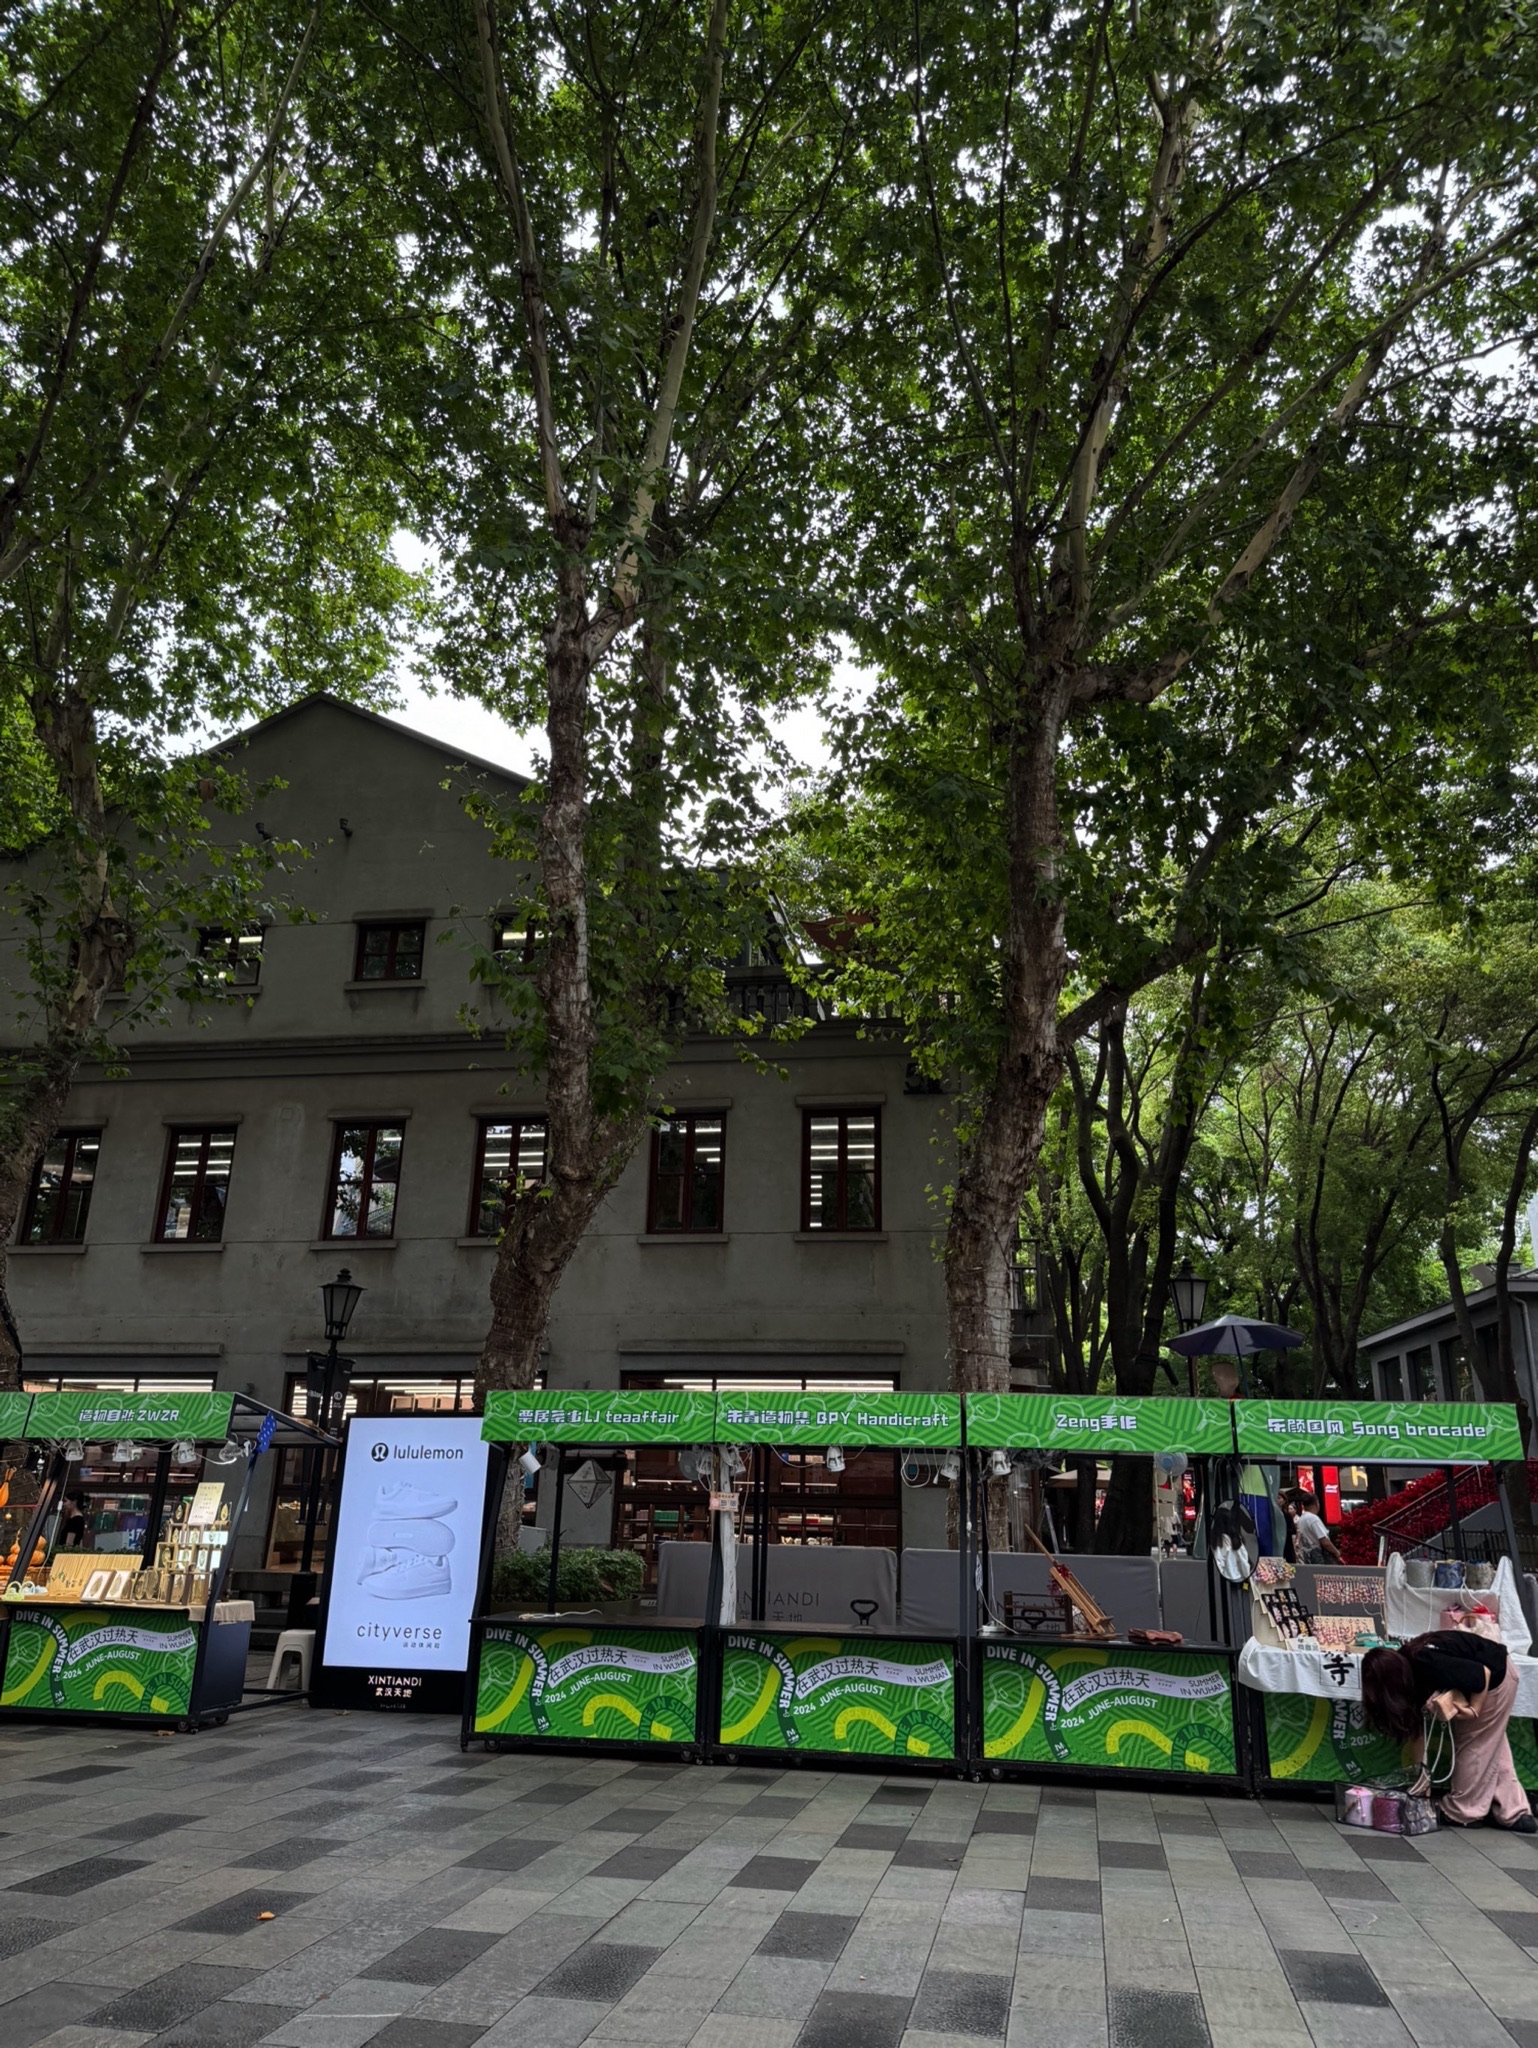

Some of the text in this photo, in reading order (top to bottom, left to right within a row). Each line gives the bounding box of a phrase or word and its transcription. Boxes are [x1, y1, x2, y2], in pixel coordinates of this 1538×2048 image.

[605, 1410, 679, 1424] teaaffair
[816, 1411, 850, 1426] BPY
[857, 1412, 949, 1427] Handicraft
[1352, 1420, 1401, 1439] Song
[1405, 1422, 1488, 1438] brocade
[393, 1445, 464, 1459] lululemon
[167, 1630, 192, 1642] SUMMER
[357, 1622, 442, 1642] cityverse
[16, 1610, 69, 1674] DIVE IN SUMMER
[69, 1628, 138, 1660] 在武汉过热天
[168, 1638, 193, 1649] WUHAN
[63, 1650, 141, 1679] 2024 JUNE-AUGUST
[486, 1627, 549, 1698] DIVE IN SUMMER
[652, 1657, 692, 1671] IN WUHAN
[660, 1649, 690, 1663] SUMMER
[549, 1648, 628, 1684] 在武汉过热天
[728, 1636, 796, 1709] DIVE IN SUMMER
[914, 1662, 945, 1675] SUMMER
[368, 1675, 422, 1687] XINTIANDI
[797, 1658, 880, 1695] 在武汉过热天
[906, 1671, 948, 1683] IN WUHAN
[986, 1646, 1061, 1721] DIVE IN SUMMER
[1188, 1672, 1221, 1688] SUMMER
[375, 1688, 412, 1698] 武汉天地
[544, 1672, 633, 1704] 2024 JUNE-AUGUST
[1062, 1669, 1150, 1707] 在武汉过热天
[1180, 1682, 1225, 1696] IN WUHAN
[793, 1683, 885, 1715] 2024 JUNE-AUGUST
[1060, 1696, 1158, 1728] 2024 JUNE-AUGUST
[1350, 1732, 1376, 1747] 2024
